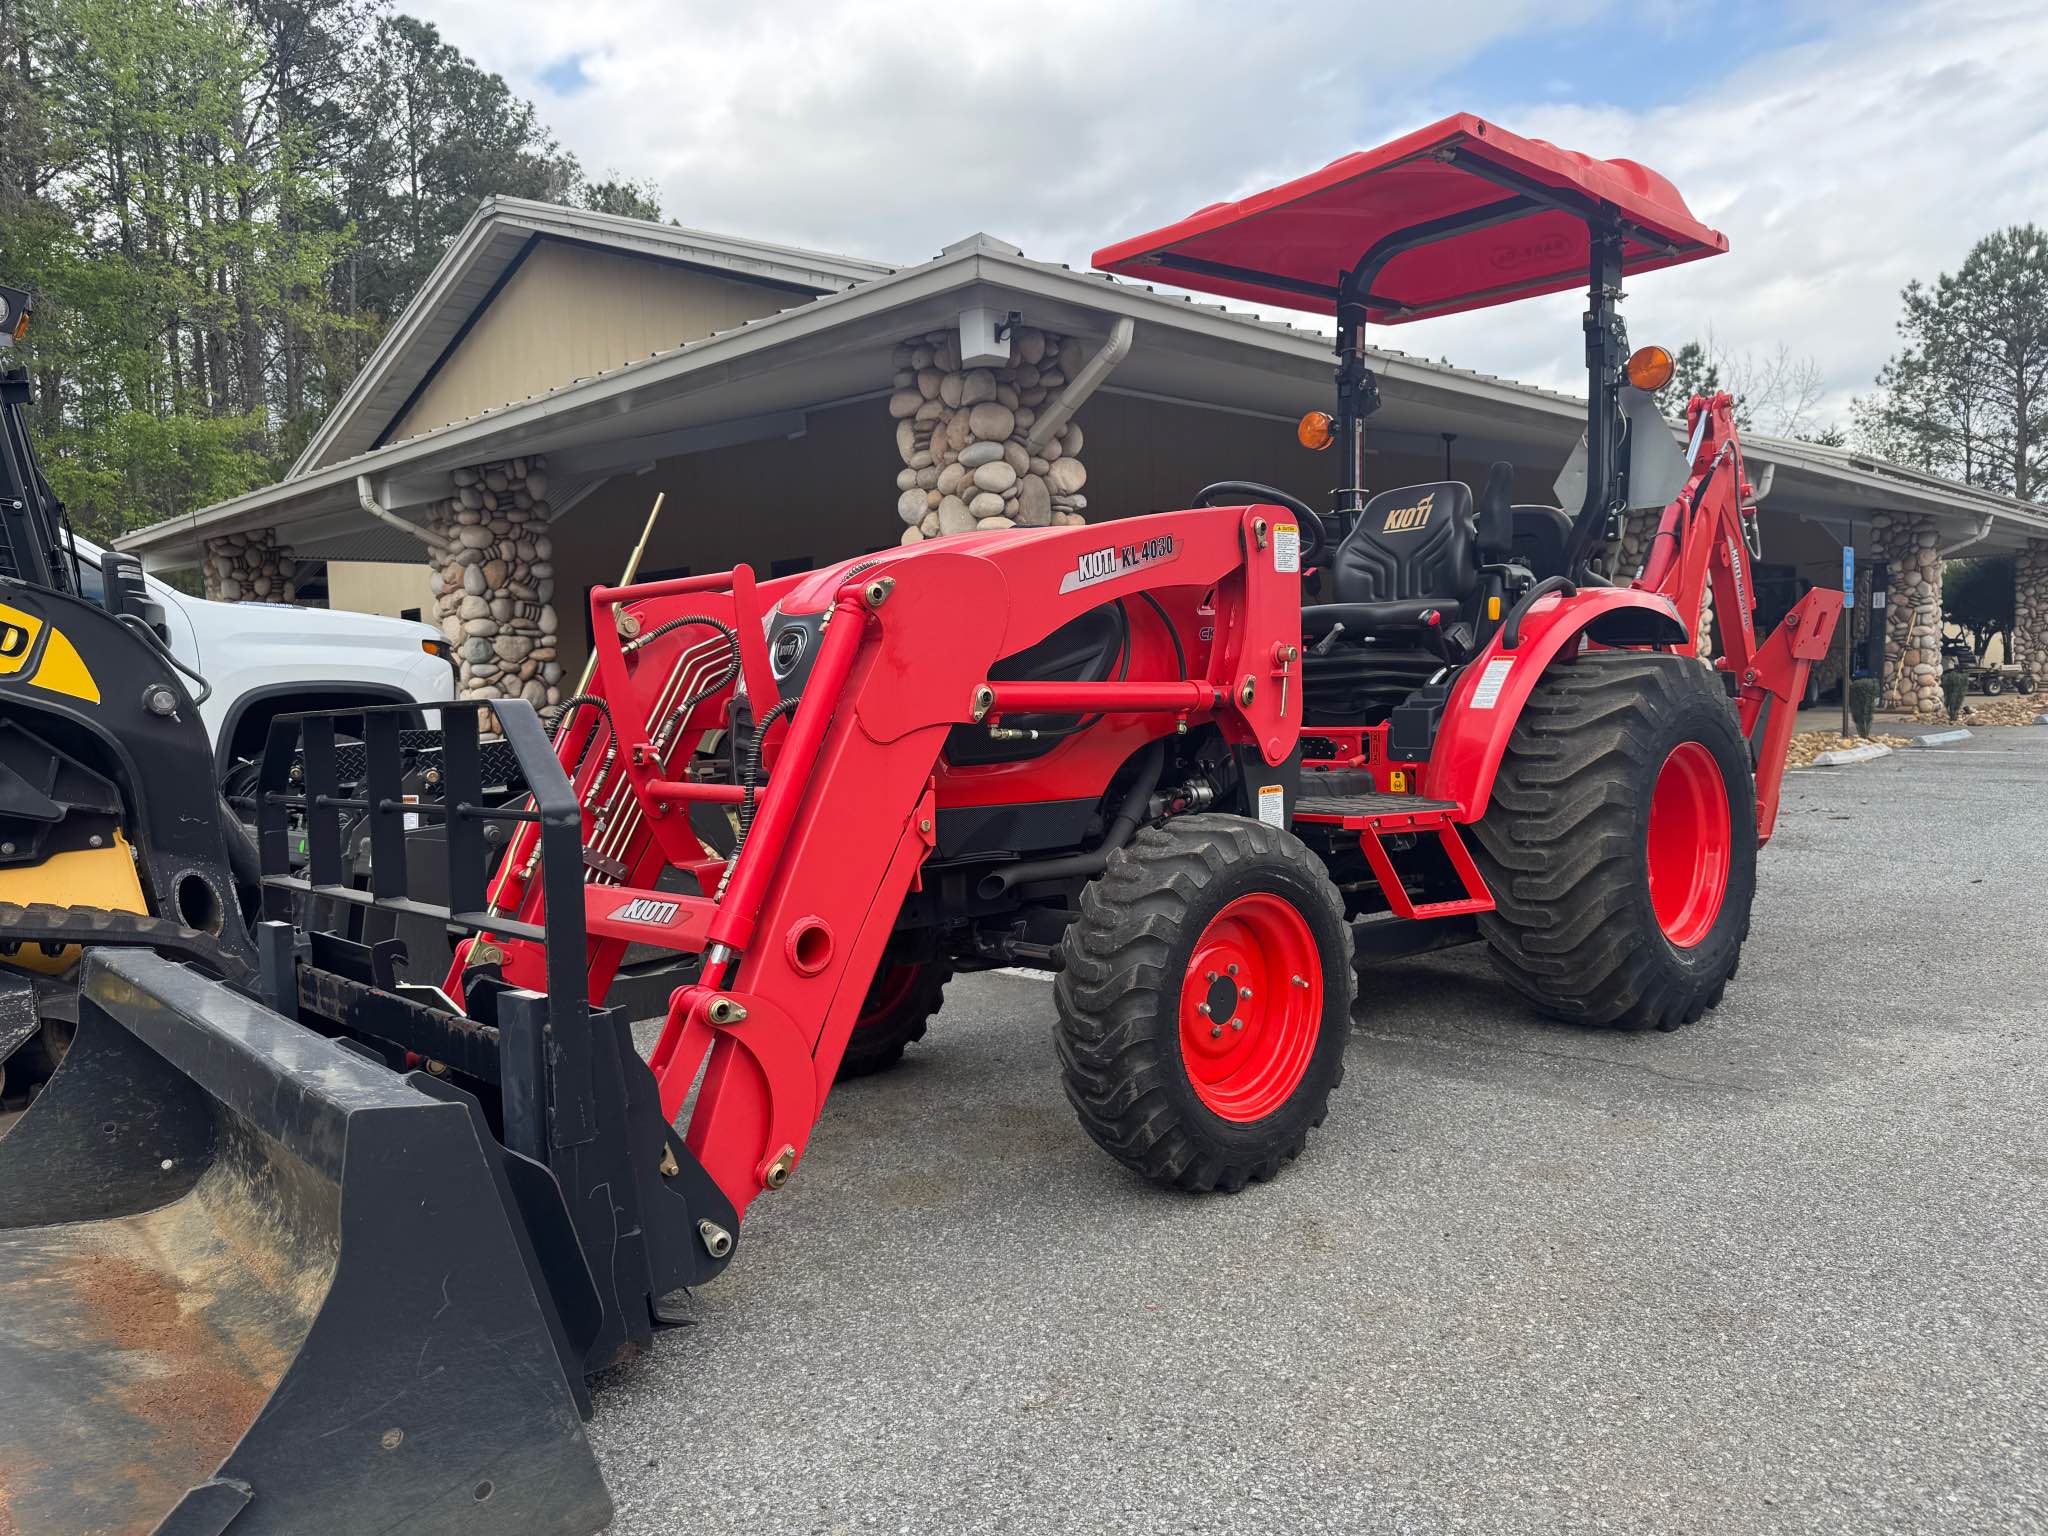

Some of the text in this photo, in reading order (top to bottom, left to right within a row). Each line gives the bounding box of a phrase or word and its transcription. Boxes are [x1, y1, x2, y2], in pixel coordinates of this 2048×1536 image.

[1383, 500, 1434, 531] KIOTI
[1078, 534, 1174, 582] KIOTI KL 4030
[623, 897, 681, 925] KIOTI
